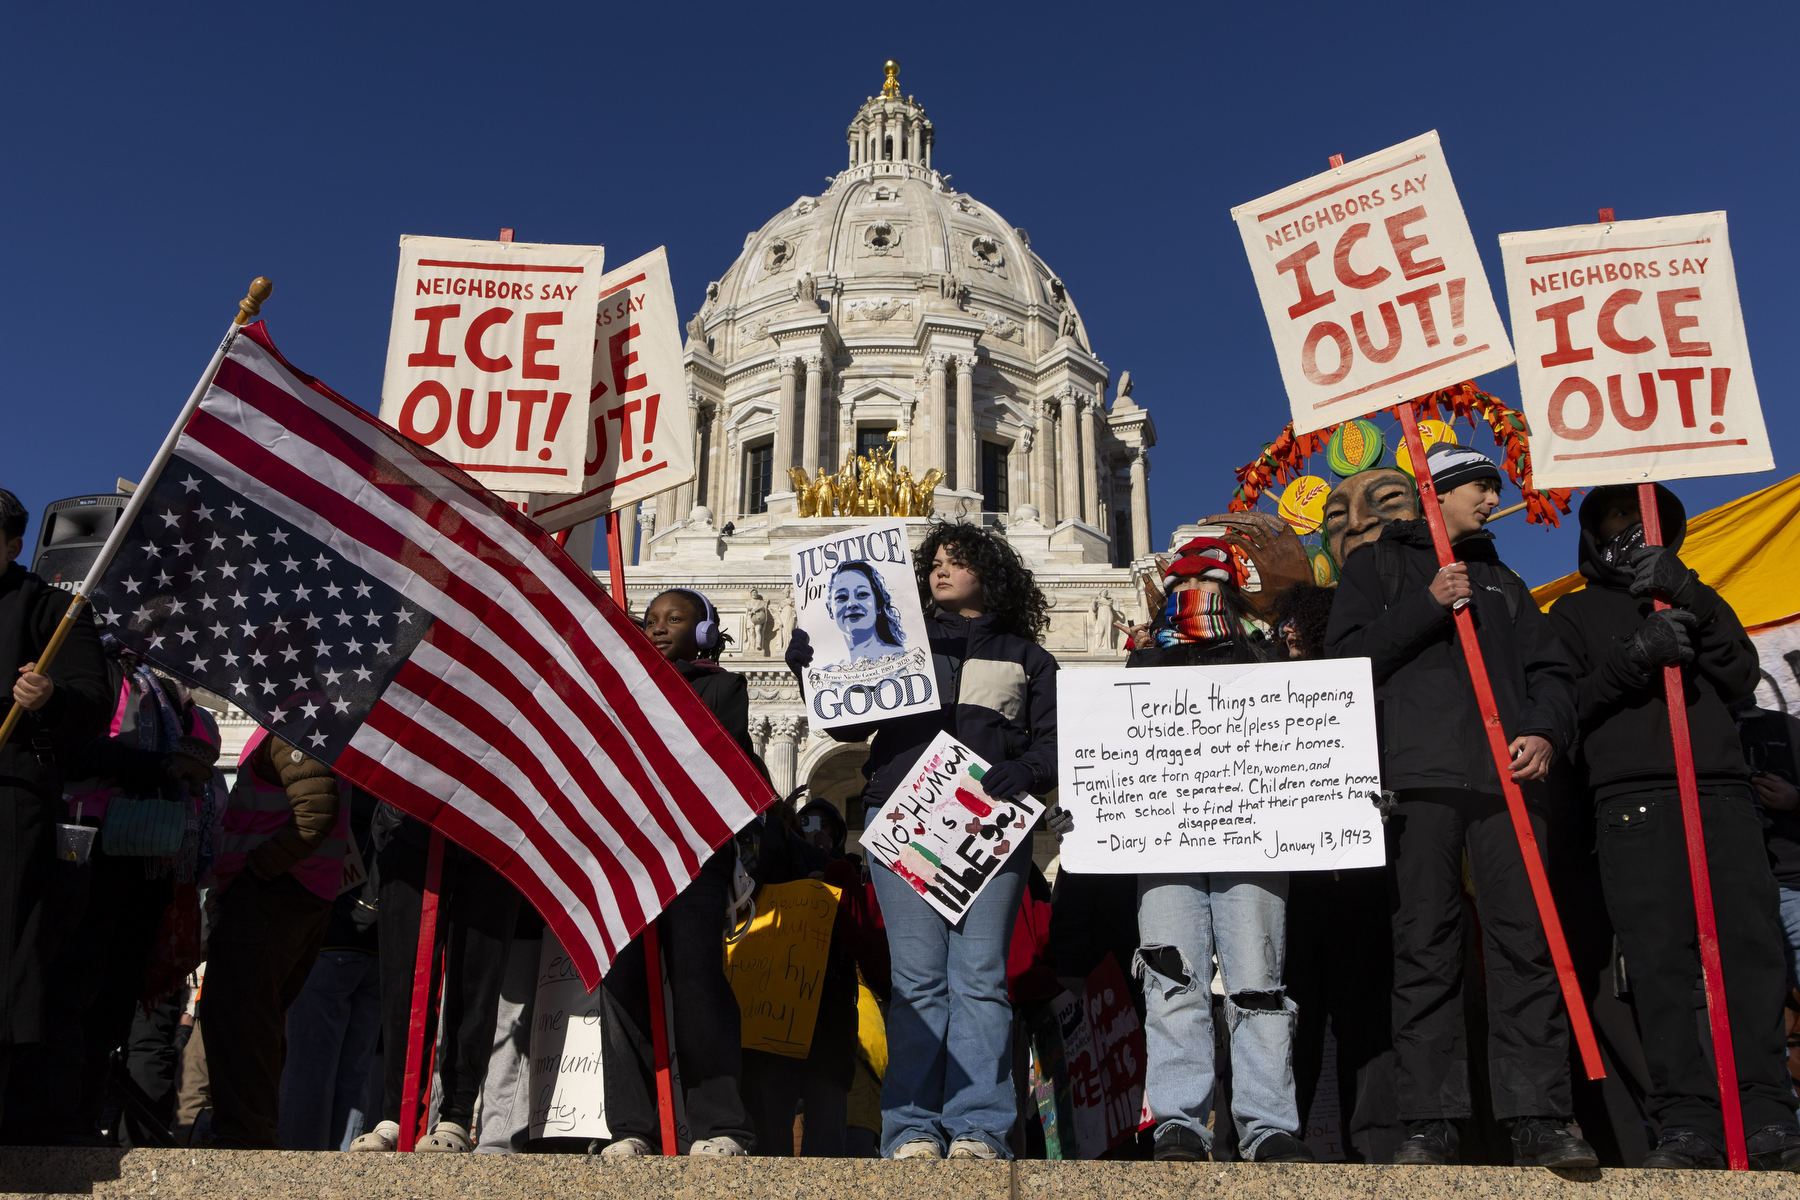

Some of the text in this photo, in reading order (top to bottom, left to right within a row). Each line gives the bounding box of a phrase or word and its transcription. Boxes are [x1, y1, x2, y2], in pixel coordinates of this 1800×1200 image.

[1266, 173, 1428, 252] NEIGHBORS SAY
[1275, 204, 1447, 321] ICE
[1530, 257, 1710, 297] NEIGHBORS SAY
[416, 277, 578, 301] NEIGHBORS SAY
[616, 293, 646, 319] SAY
[407, 303, 565, 381] ICE
[1301, 277, 1469, 386] OUT!
[1535, 286, 1713, 368] ICE
[398, 379, 573, 462] OUT!
[1547, 366, 1732, 441] OUT!
[584, 393, 662, 477] UT!
[795, 526, 907, 588] JUSTICE
[800, 576, 827, 611] for
[813, 673, 933, 721] GOOD
[1114, 679, 1356, 721] Terrible things are happening
[1226, 716, 1280, 738] helpless
[1285, 713, 1340, 736] people
[1074, 736, 1345, 766] are being dragged out of their homes.
[1072, 766, 1135, 796] Families
[1138, 772, 1158, 784] are
[1161, 767, 1190, 782] torn
[1090, 772, 1380, 806] children are separated. Children come home
[1095, 807, 1127, 824] from
[1134, 801, 1176, 818] school
[1182, 801, 1200, 816] to
[1203, 799, 1233, 816] find
[1238, 799, 1266, 815] that
[1266, 795, 1298, 809] their
[1300, 788, 1344, 809] parents
[1177, 813, 1257, 833] disappeared.
[1154, 831, 1173, 846] of
[1178, 831, 1217, 848] Anne
[1264, 829, 1316, 860] January
[1339, 827, 1373, 848] 1943
